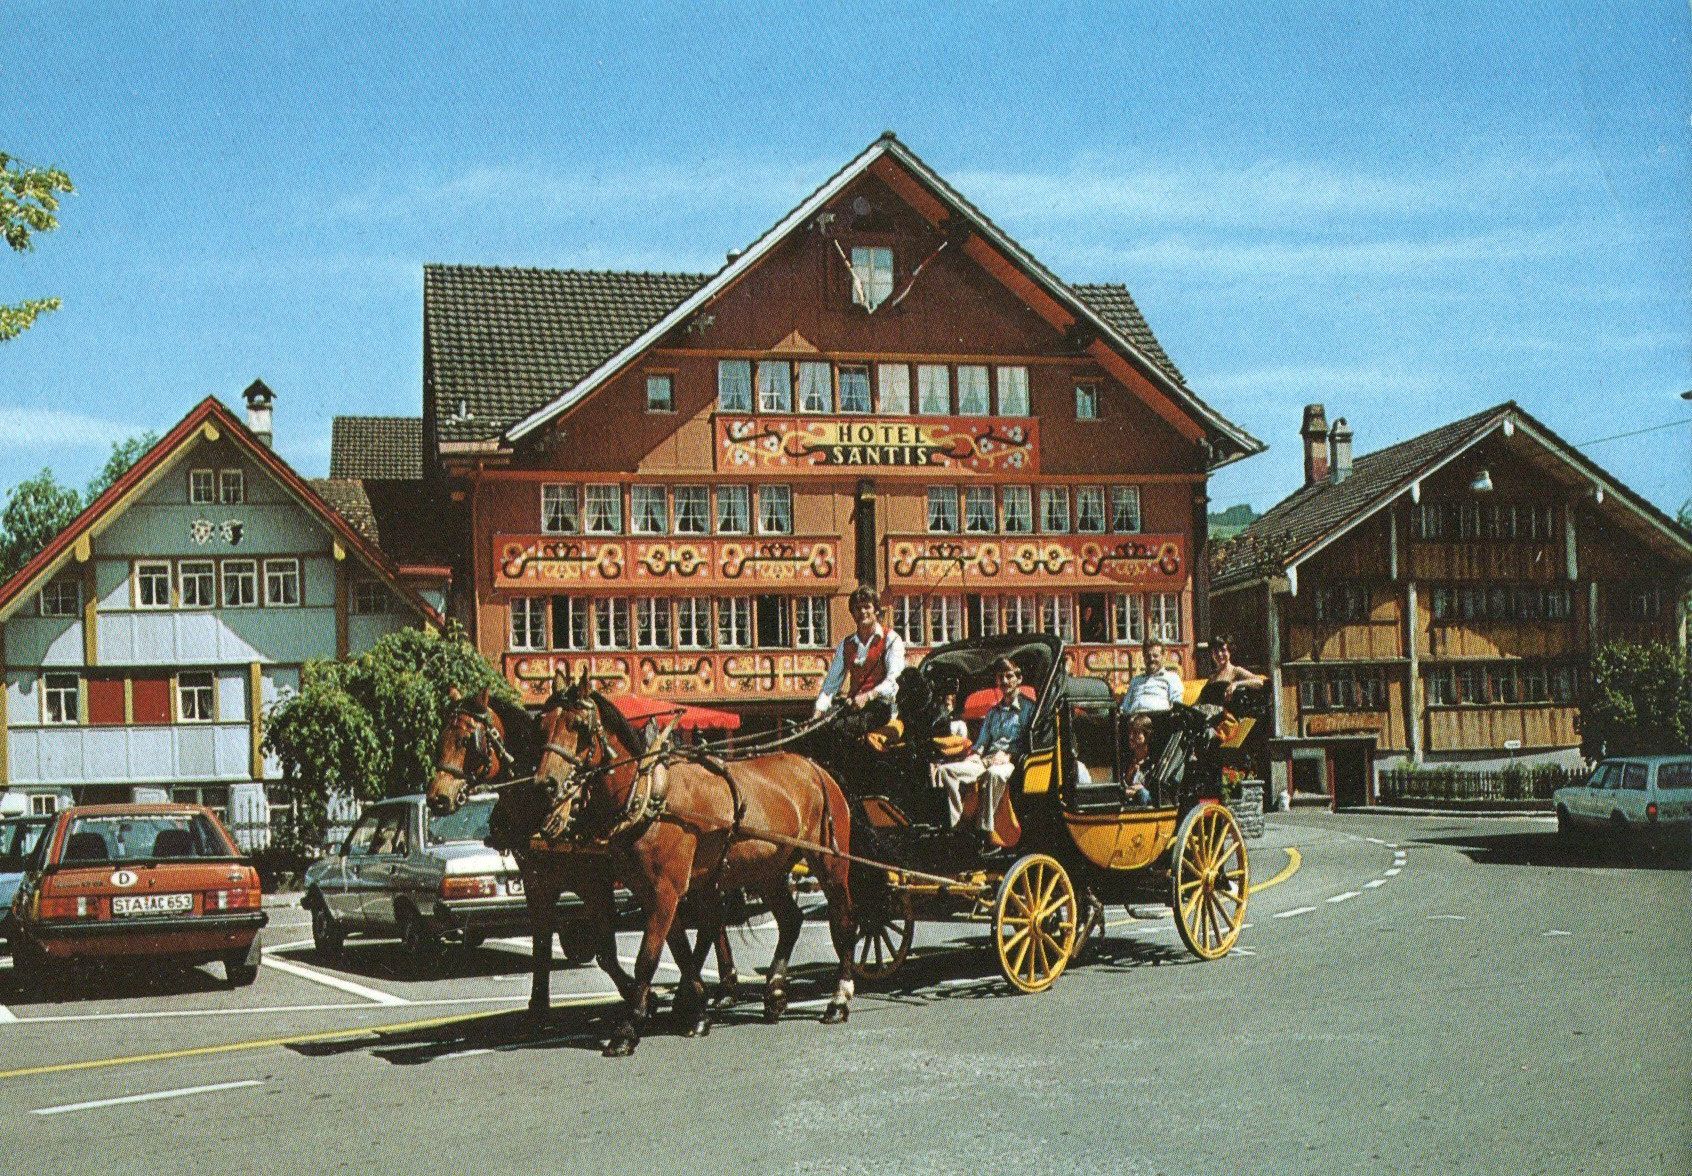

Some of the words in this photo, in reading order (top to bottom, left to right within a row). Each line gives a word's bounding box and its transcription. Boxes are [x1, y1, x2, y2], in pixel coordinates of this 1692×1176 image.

[839, 425, 926, 443] HOTEL
[119, 872, 130, 884] D
[114, 898, 143, 912] STA
[167, 895, 191, 909] 653
